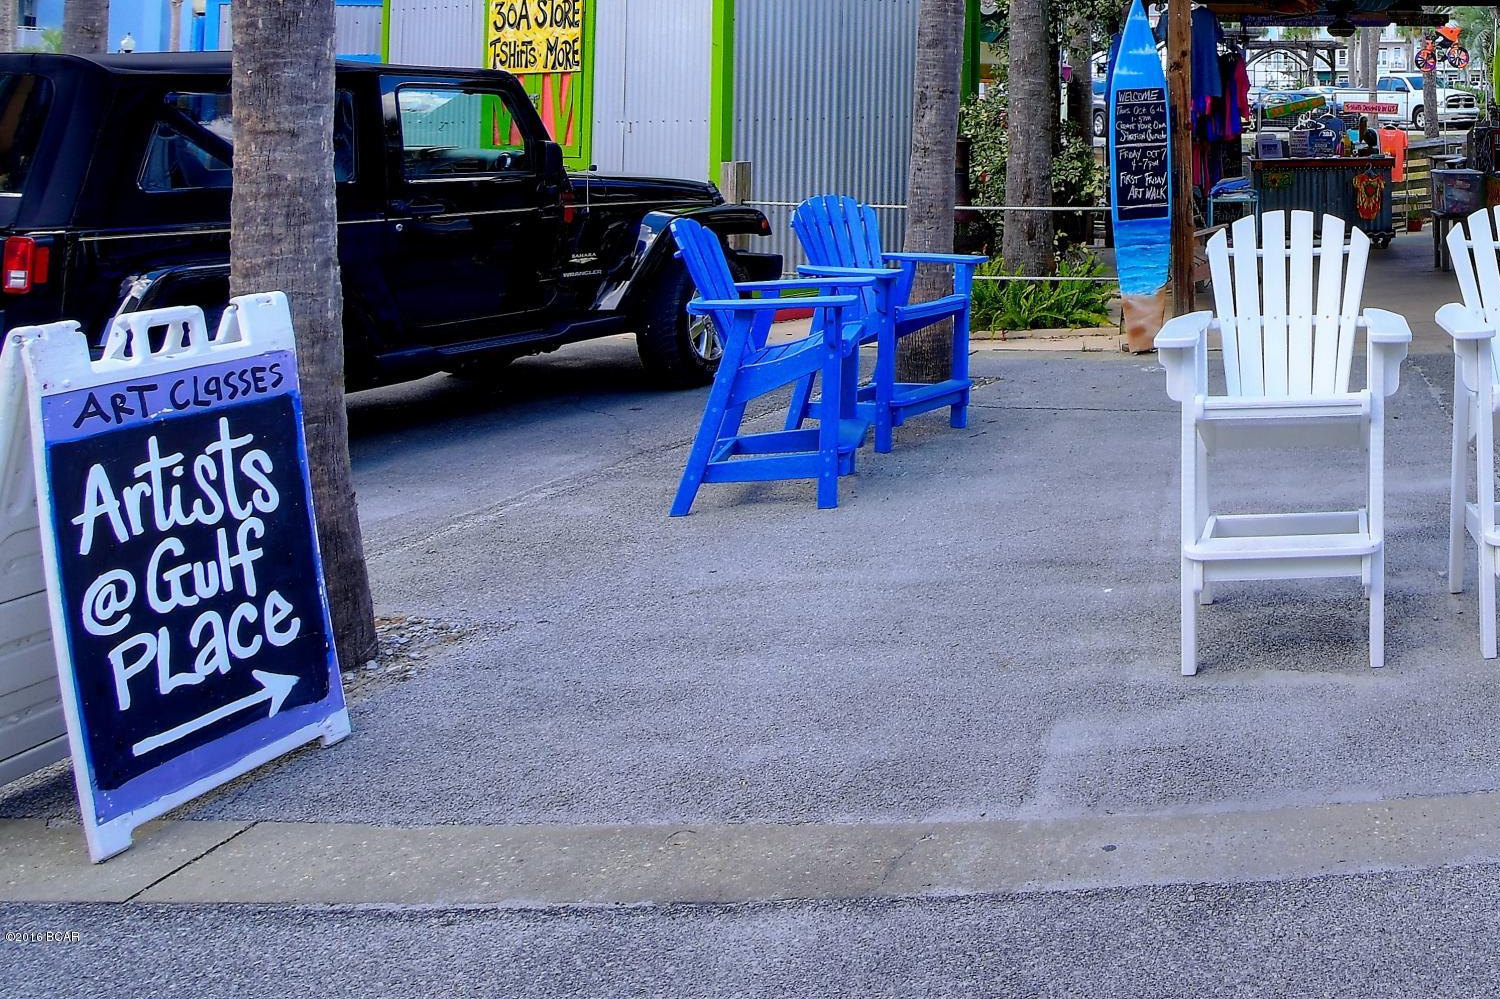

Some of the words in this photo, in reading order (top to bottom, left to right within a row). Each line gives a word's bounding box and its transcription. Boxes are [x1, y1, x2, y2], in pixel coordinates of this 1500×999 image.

[1118, 90, 1160, 102] WELCOME
[1120, 171, 1143, 188] FIRST
[1145, 184, 1168, 201] WALK
[72, 384, 159, 431] ART
[71, 416, 281, 557] Artists
[81, 567, 138, 636] @
[145, 516, 265, 616] Gulf
